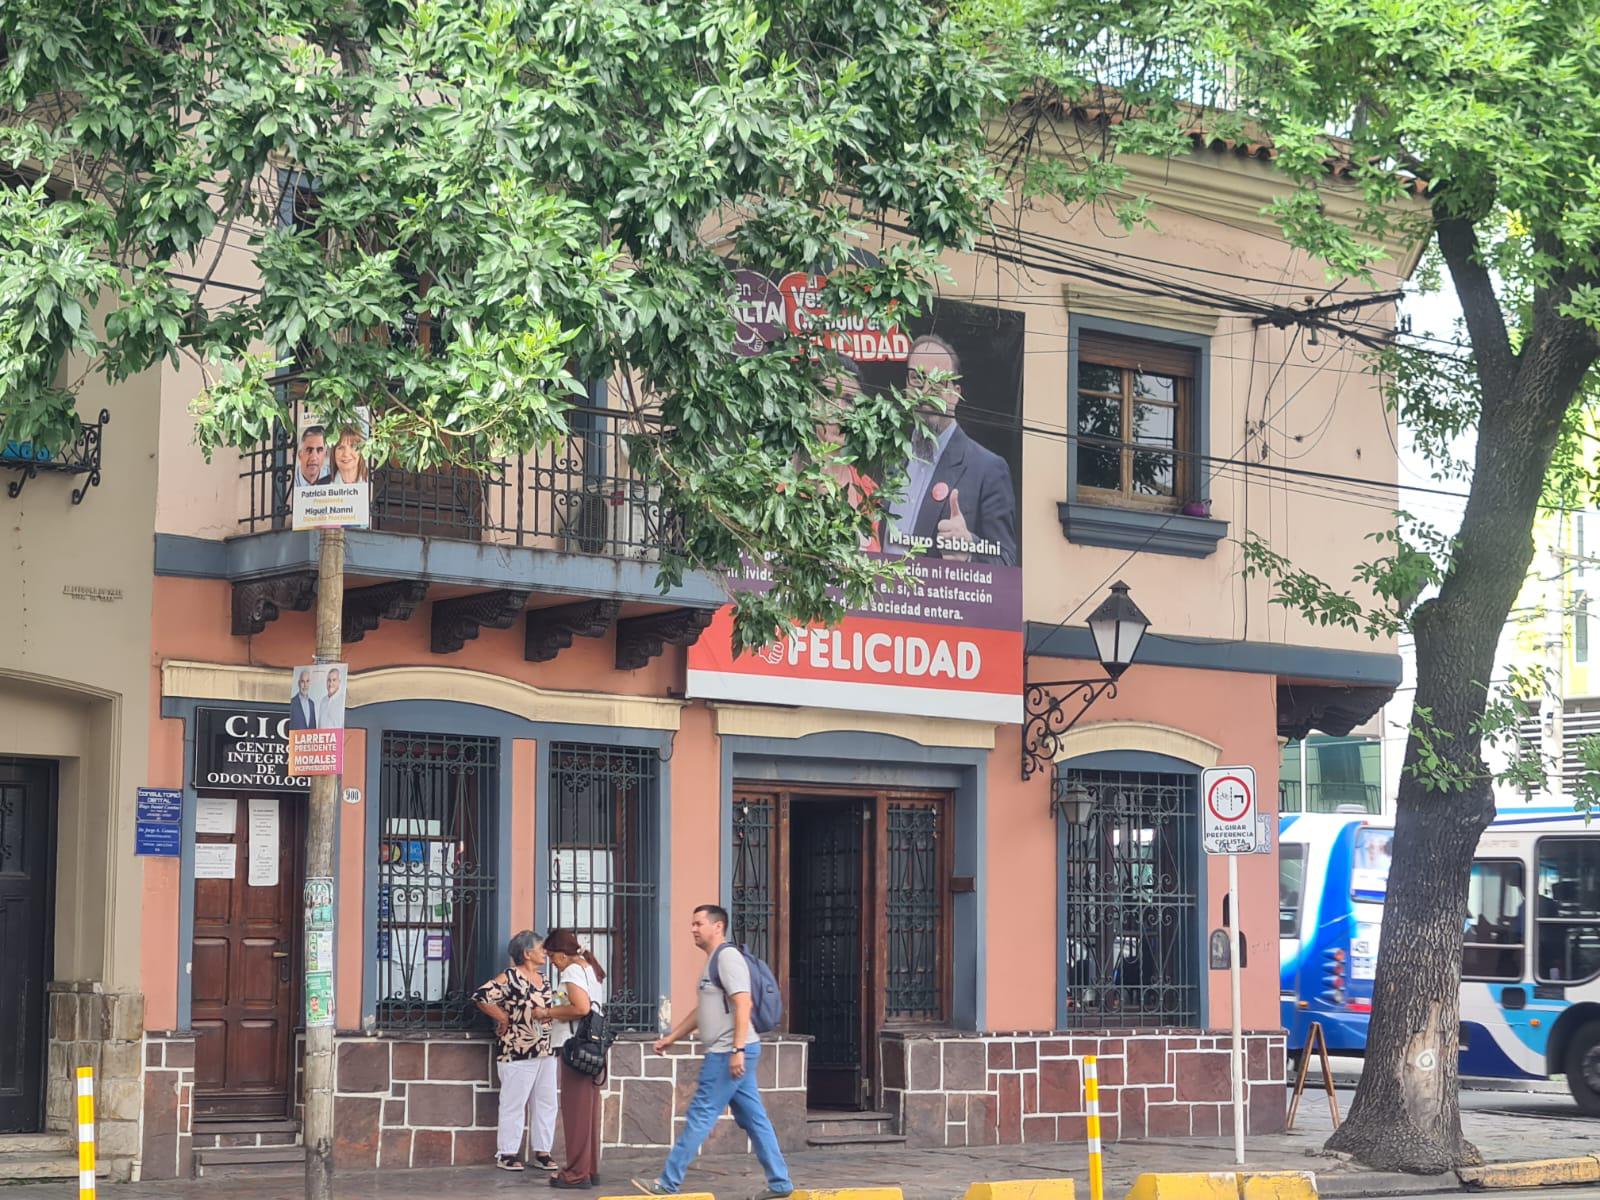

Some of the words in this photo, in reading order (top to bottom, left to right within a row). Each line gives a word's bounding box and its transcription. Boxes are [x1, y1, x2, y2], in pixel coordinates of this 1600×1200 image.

[735, 283, 752, 296] en
[727, 300, 784, 324] ALTA
[794, 308, 864, 332] Cmbio
[794, 334, 909, 360] EICIDAD
[301, 489, 327, 498] Patricia
[328, 487, 359, 497] Bullrich
[305, 506, 328, 515] Miguel
[329, 505, 353, 514] Nanni
[889, 532, 933, 548] Mauro
[936, 536, 1001, 556] Sabbadini
[932, 566, 942, 579] ni
[945, 567, 993, 584] felicidad
[913, 582, 925, 597] la
[927, 587, 993, 603] satisfacción
[871, 601, 921, 616] sociedad
[924, 605, 964, 620] entera.
[787, 627, 981, 680] FELICIDAD
[295, 732, 337, 745] LARRETA
[295, 743, 337, 753] PRESIDENTE
[227, 751, 290, 765] INTEGR
[295, 754, 337, 766] MORALES
[257, 764, 276, 775] DE
[207, 773, 312, 787] ODONTOLOGI
